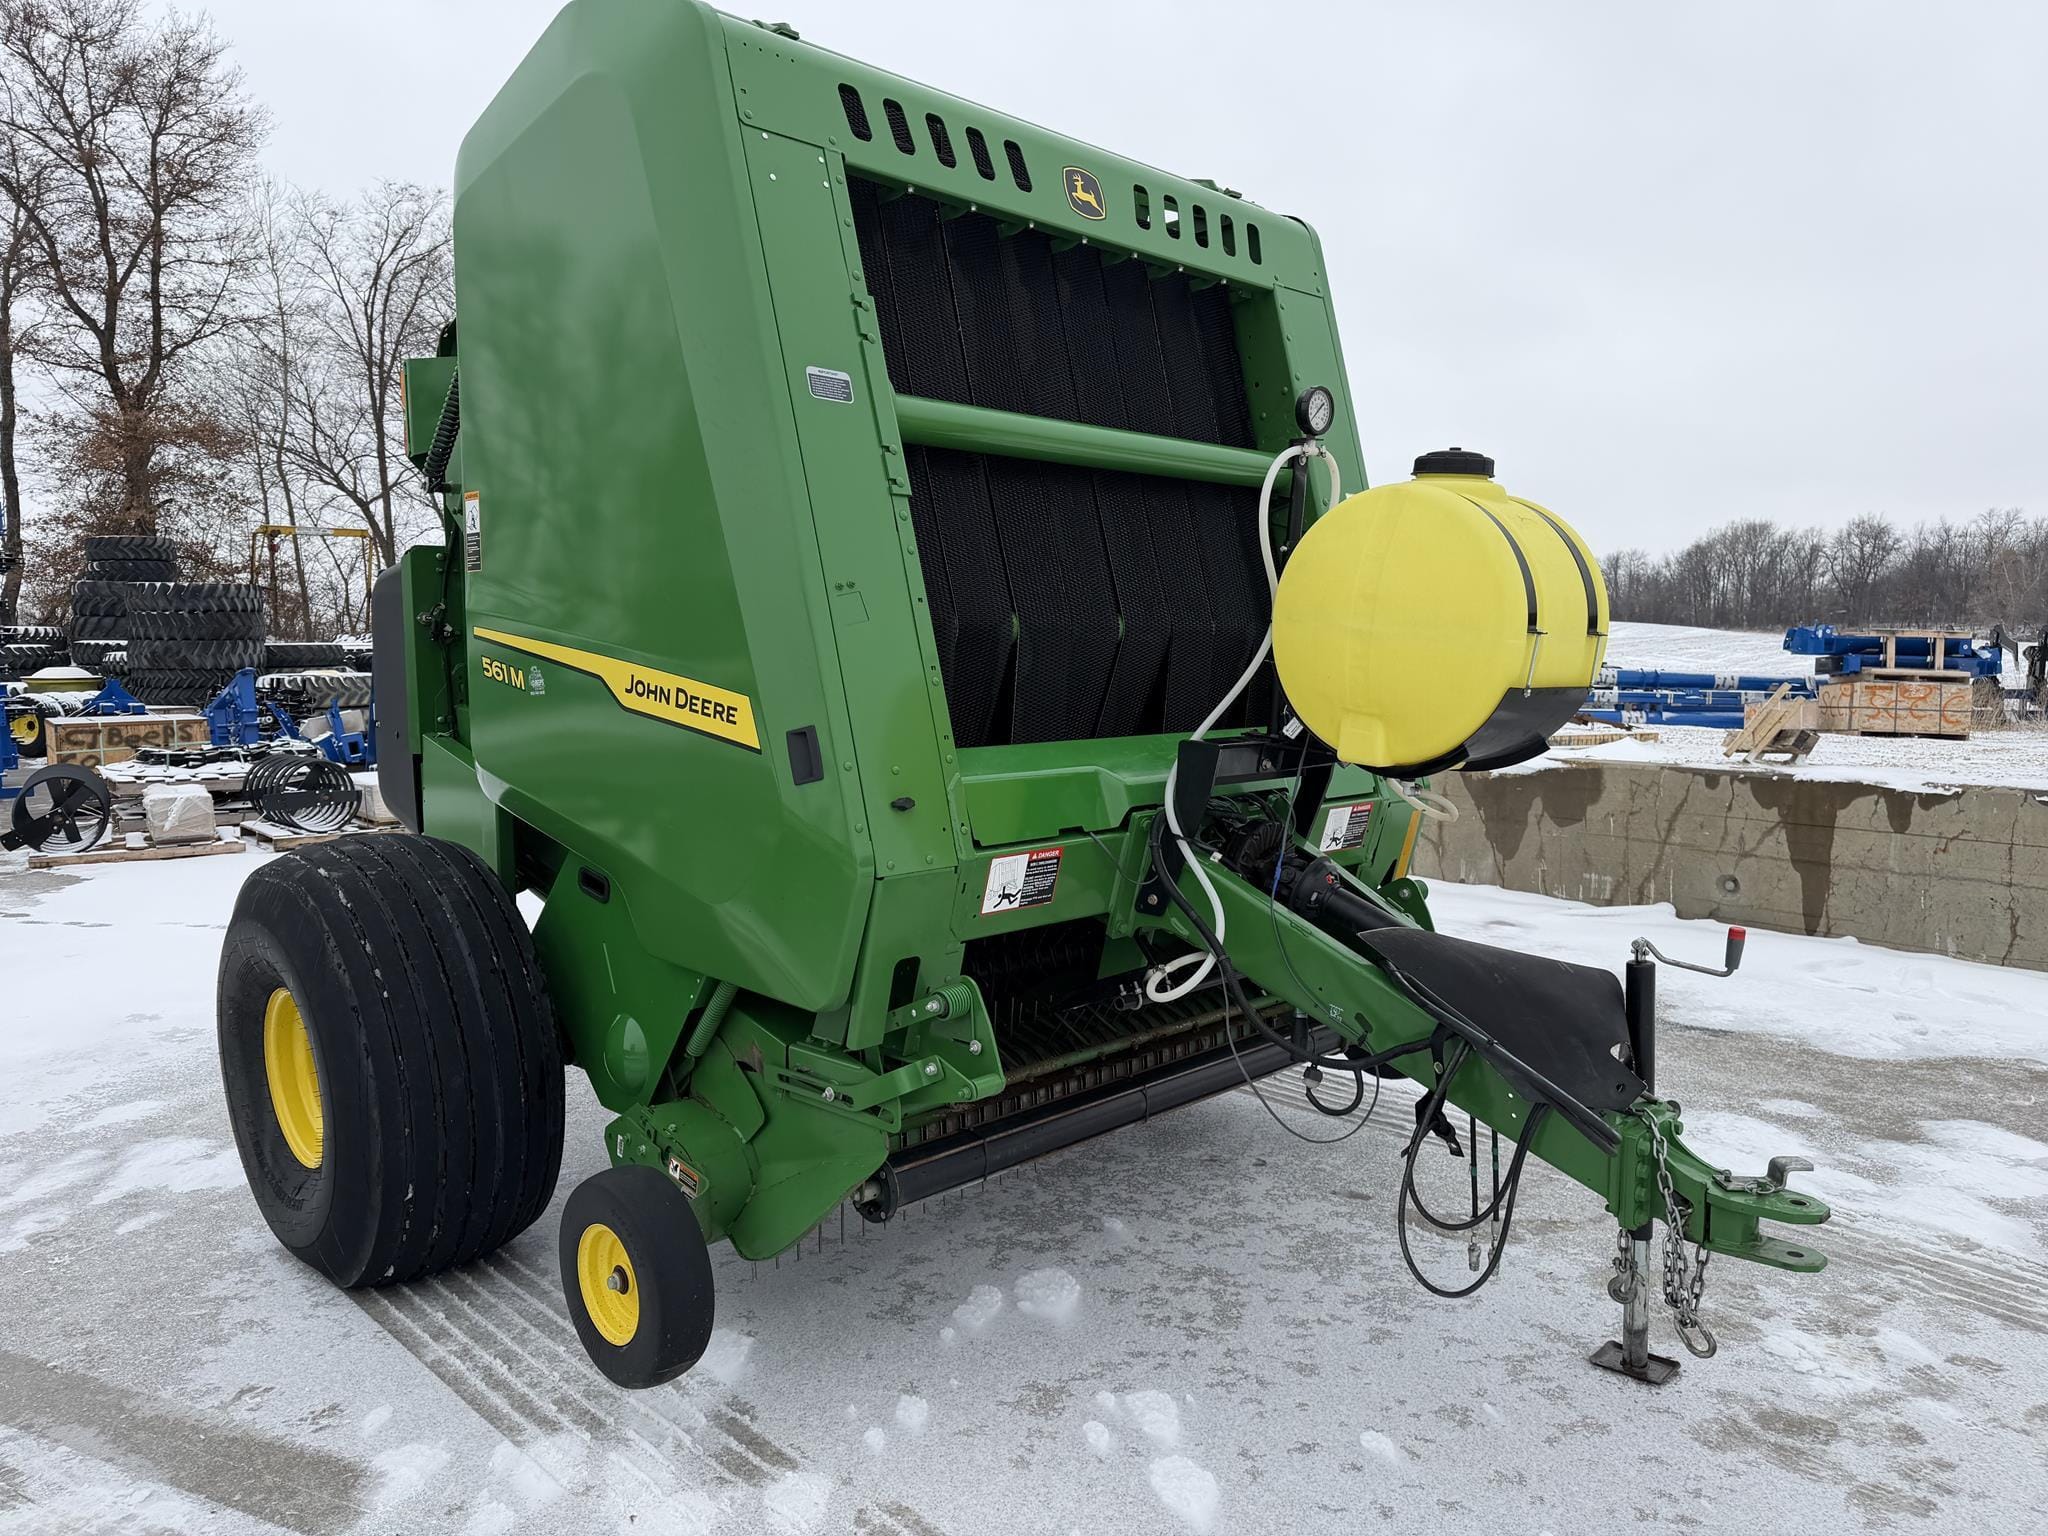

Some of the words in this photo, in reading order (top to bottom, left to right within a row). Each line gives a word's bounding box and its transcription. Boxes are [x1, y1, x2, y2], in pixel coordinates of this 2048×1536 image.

[625, 674, 671, 706] JOHN
[675, 687, 738, 726] DEERE
[1038, 850, 1060, 859] DANGER
